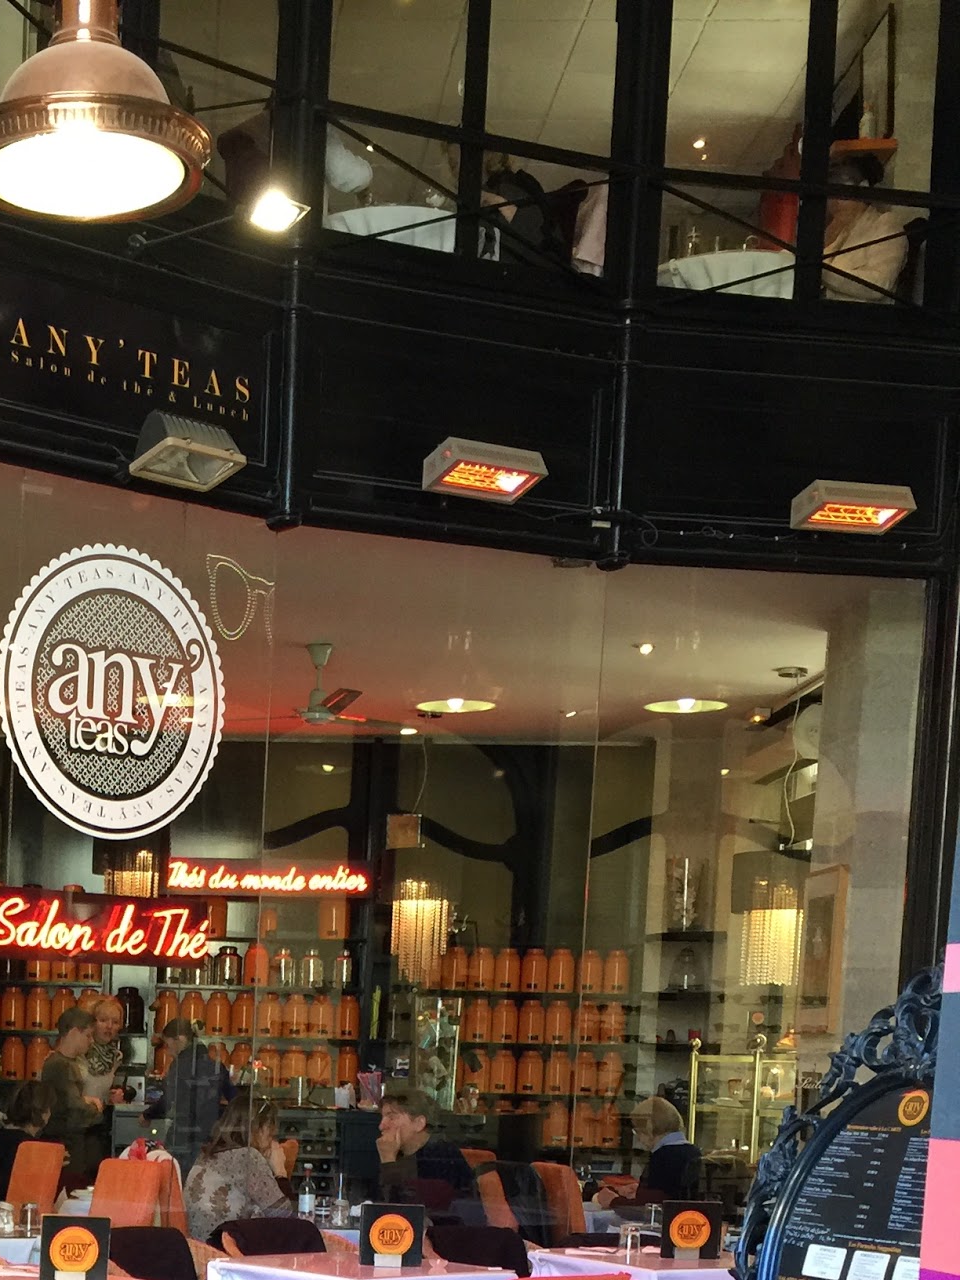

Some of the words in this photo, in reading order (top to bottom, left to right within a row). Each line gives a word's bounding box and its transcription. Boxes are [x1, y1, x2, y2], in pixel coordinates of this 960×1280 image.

[10, 317, 251, 403] ANY'TEAS
[10, 350, 71, 377] Salon
[87, 370, 108, 386] de
[168, 390, 176, 403] &
[193, 398, 250, 421] Lunch
[68, 713, 130, 755] teas
[168, 861, 206, 889] Thés
[209, 866, 238, 890] du
[240, 866, 306, 892] monde
[309, 865, 368, 892] entier
[106, 905, 148, 953] de
[152, 908, 210, 959] Thé
